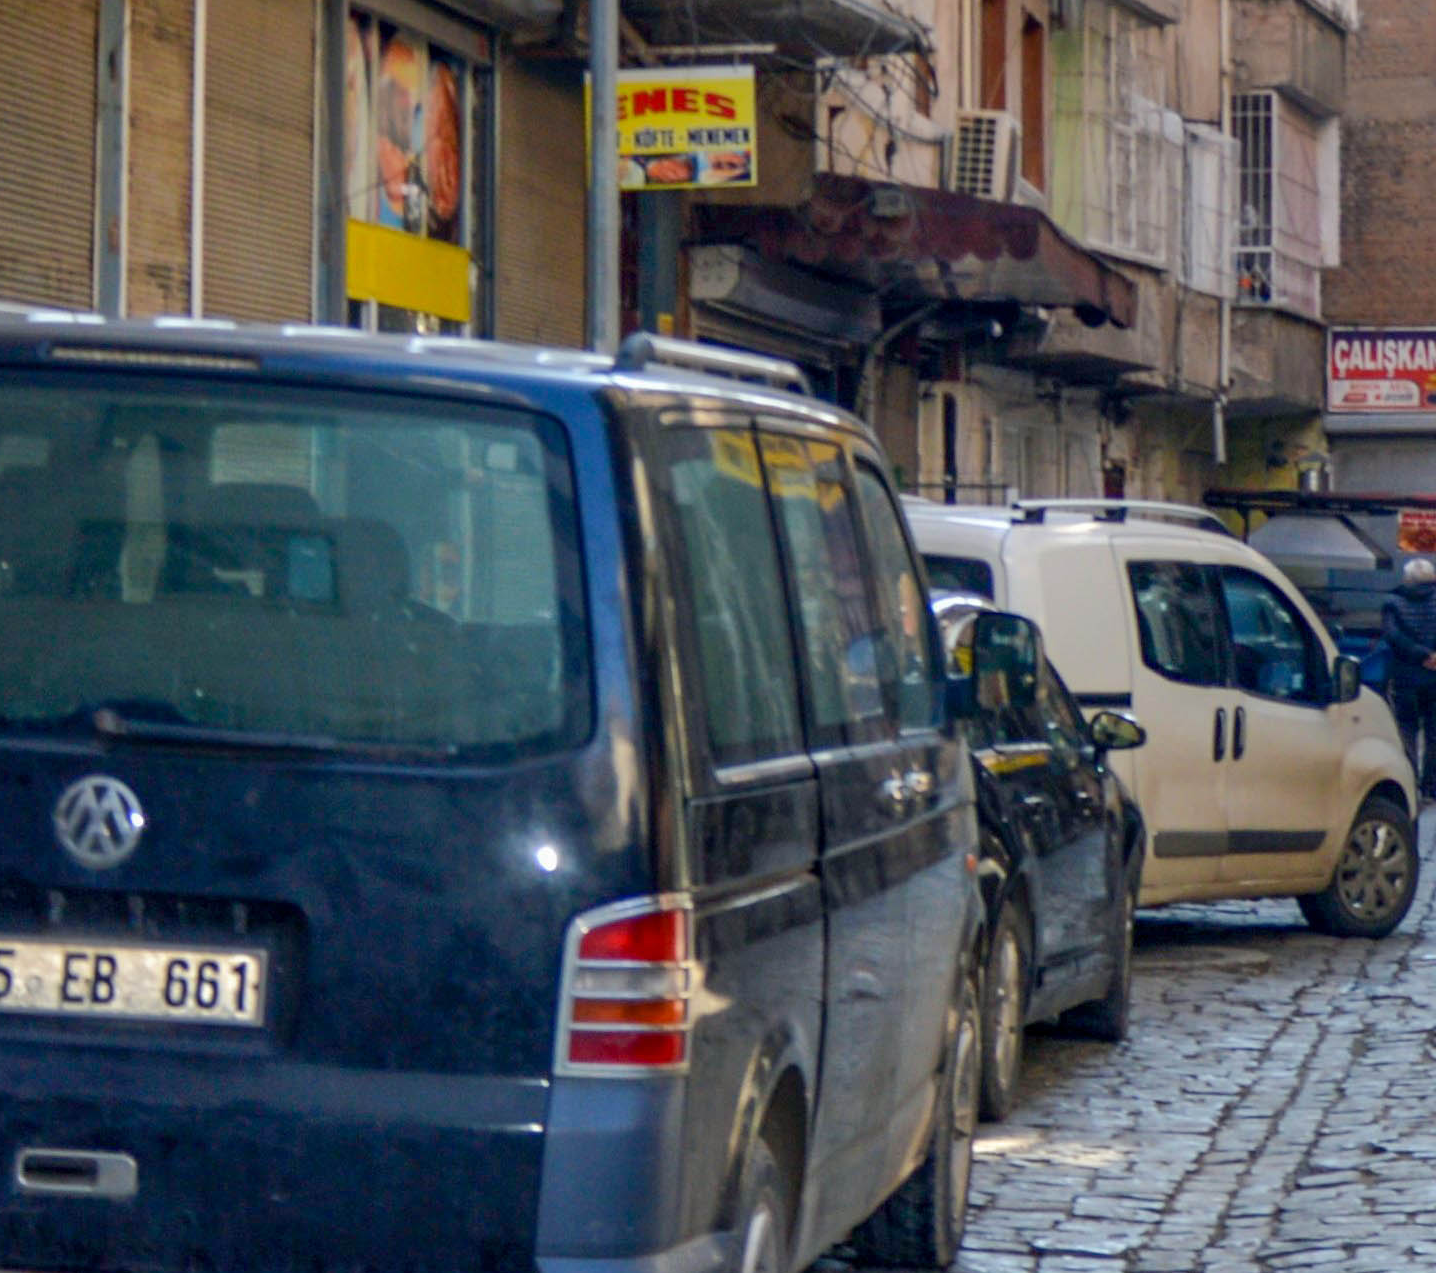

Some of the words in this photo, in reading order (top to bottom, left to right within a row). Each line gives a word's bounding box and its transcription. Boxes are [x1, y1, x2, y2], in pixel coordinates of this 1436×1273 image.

[687, 126, 751, 147] MENEMEN
[63, 952, 119, 1005] EB
[165, 958, 249, 1013] 661
